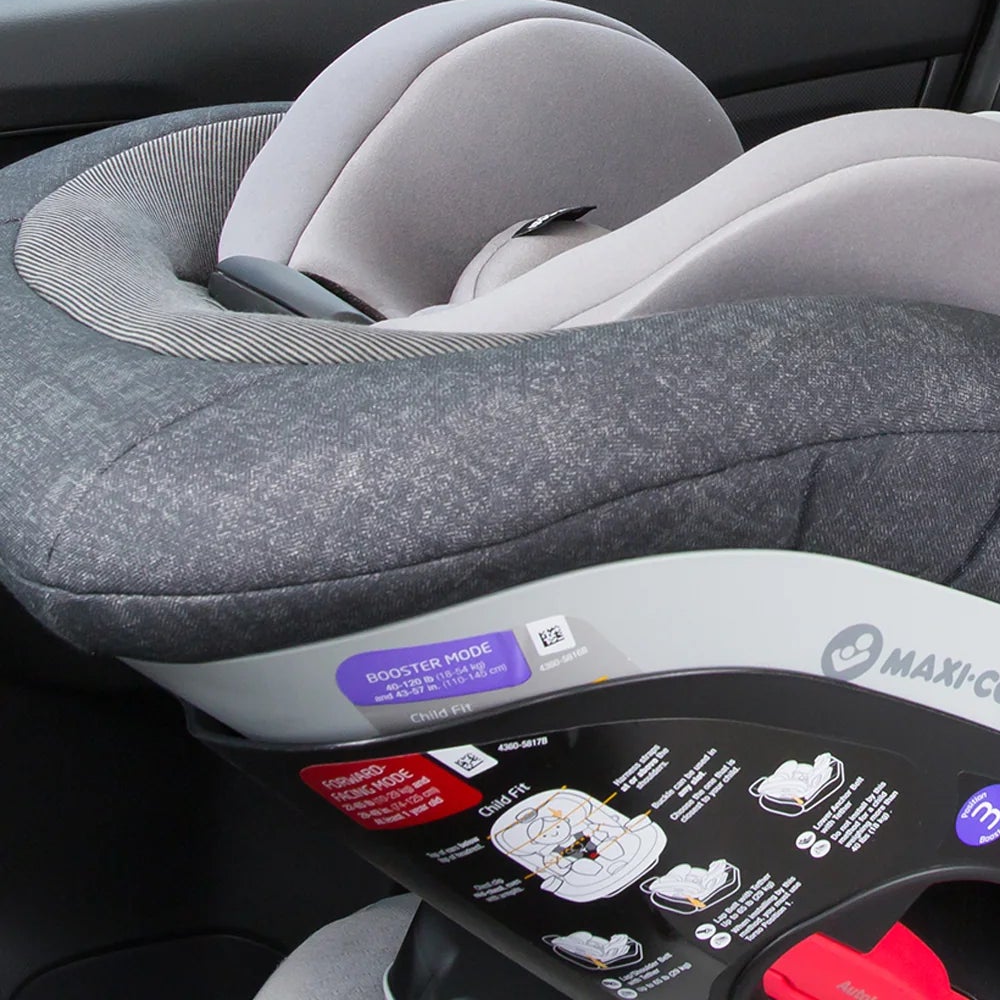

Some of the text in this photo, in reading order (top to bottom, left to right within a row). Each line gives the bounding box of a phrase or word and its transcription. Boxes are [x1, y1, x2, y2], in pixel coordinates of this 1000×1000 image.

[366, 641, 493, 684] BOOSTER MODE
[385, 676, 423, 692] 40-120
[423, 675, 435, 687] lb
[410, 702, 473, 725] Child Fit
[322, 763, 387, 790] FORWARD-
[331, 768, 414, 803] FACING MODE
[478, 781, 532, 819] Child Fit
[961, 792, 988, 819] Position
